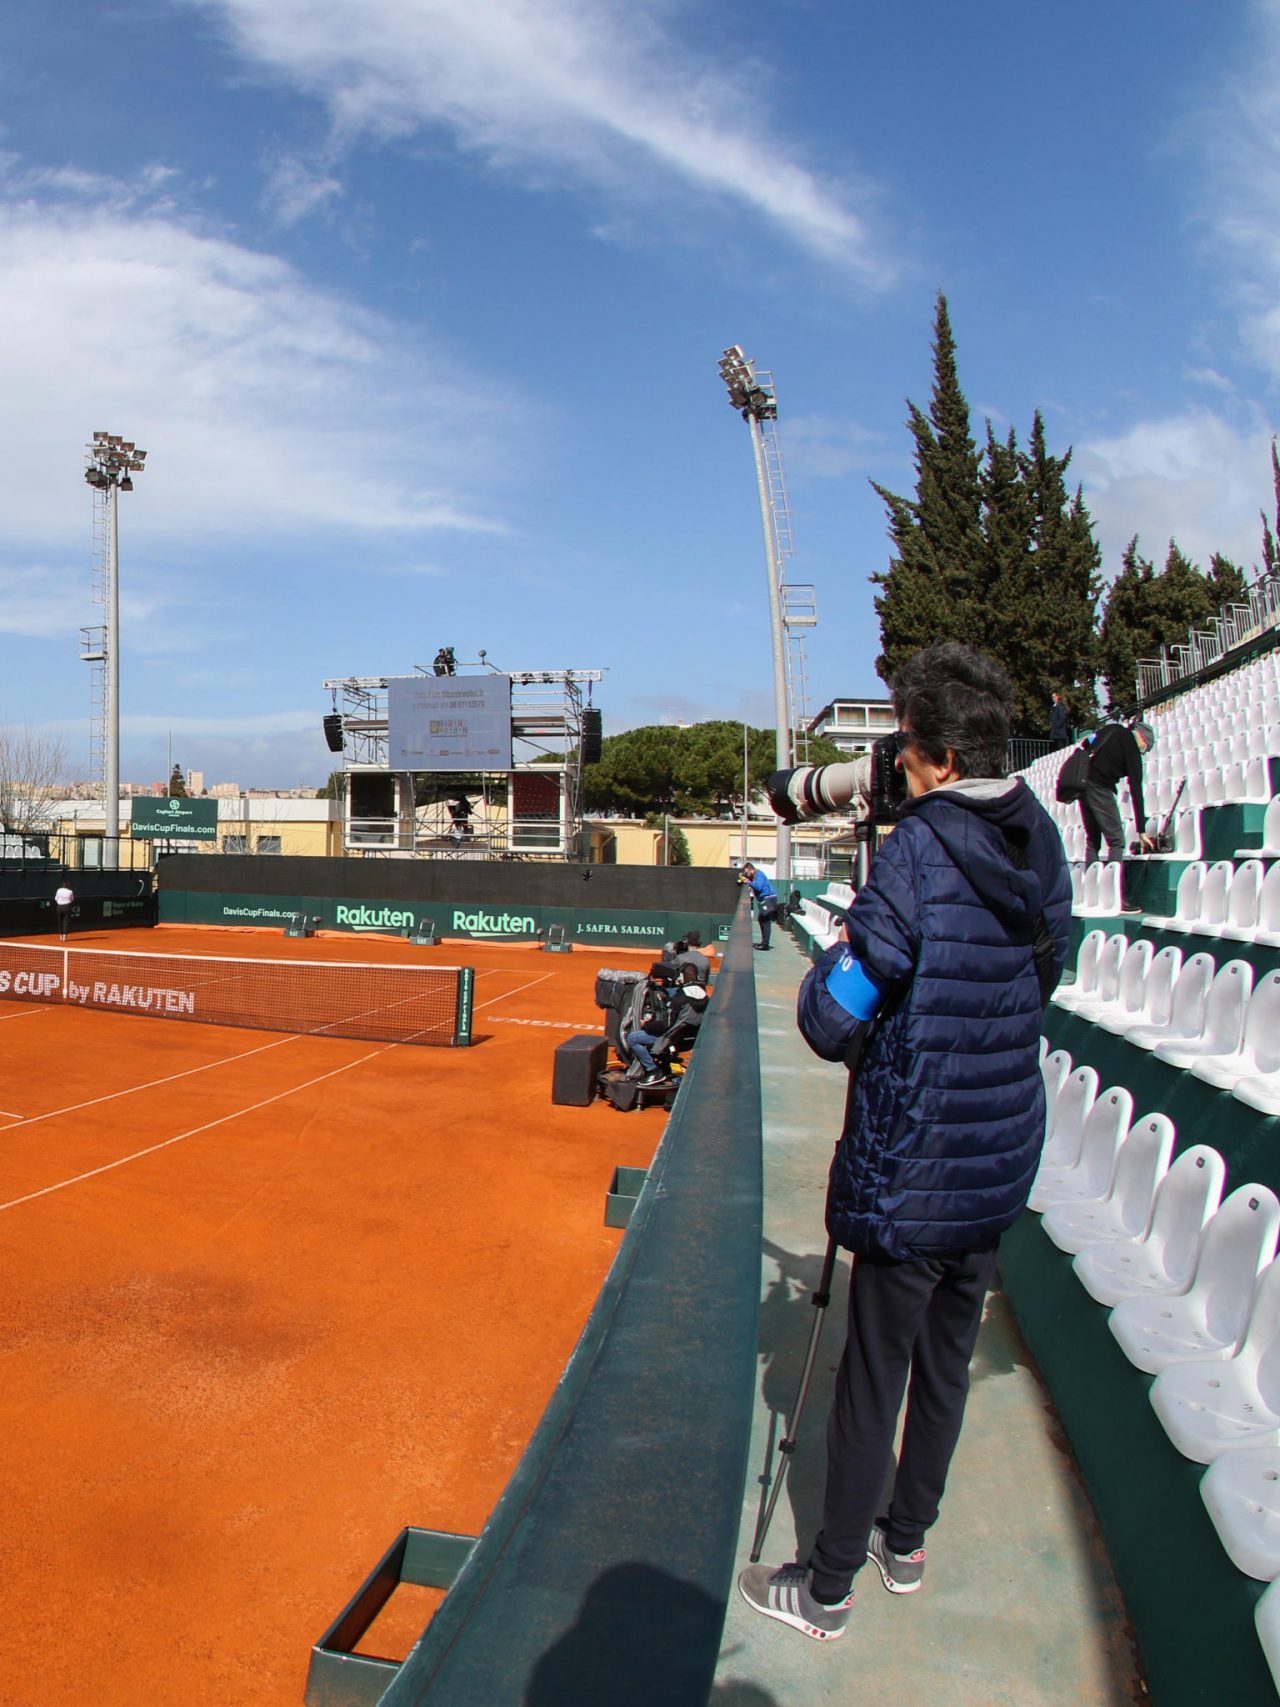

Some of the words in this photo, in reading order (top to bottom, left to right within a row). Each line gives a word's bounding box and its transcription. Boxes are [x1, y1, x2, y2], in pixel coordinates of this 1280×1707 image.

[132, 822, 215, 834] DavisCupFinals.com
[336, 905, 414, 928] Rakuten
[453, 910, 535, 933] Rakuten
[576, 923, 584, 933] J.
[586, 924, 618, 933] SAFRA
[620, 925, 664, 935] SARASIN
[13, 971, 60, 996] CUP
[69, 980, 90, 1004] by
[93, 981, 195, 1014] RAKUTEN
